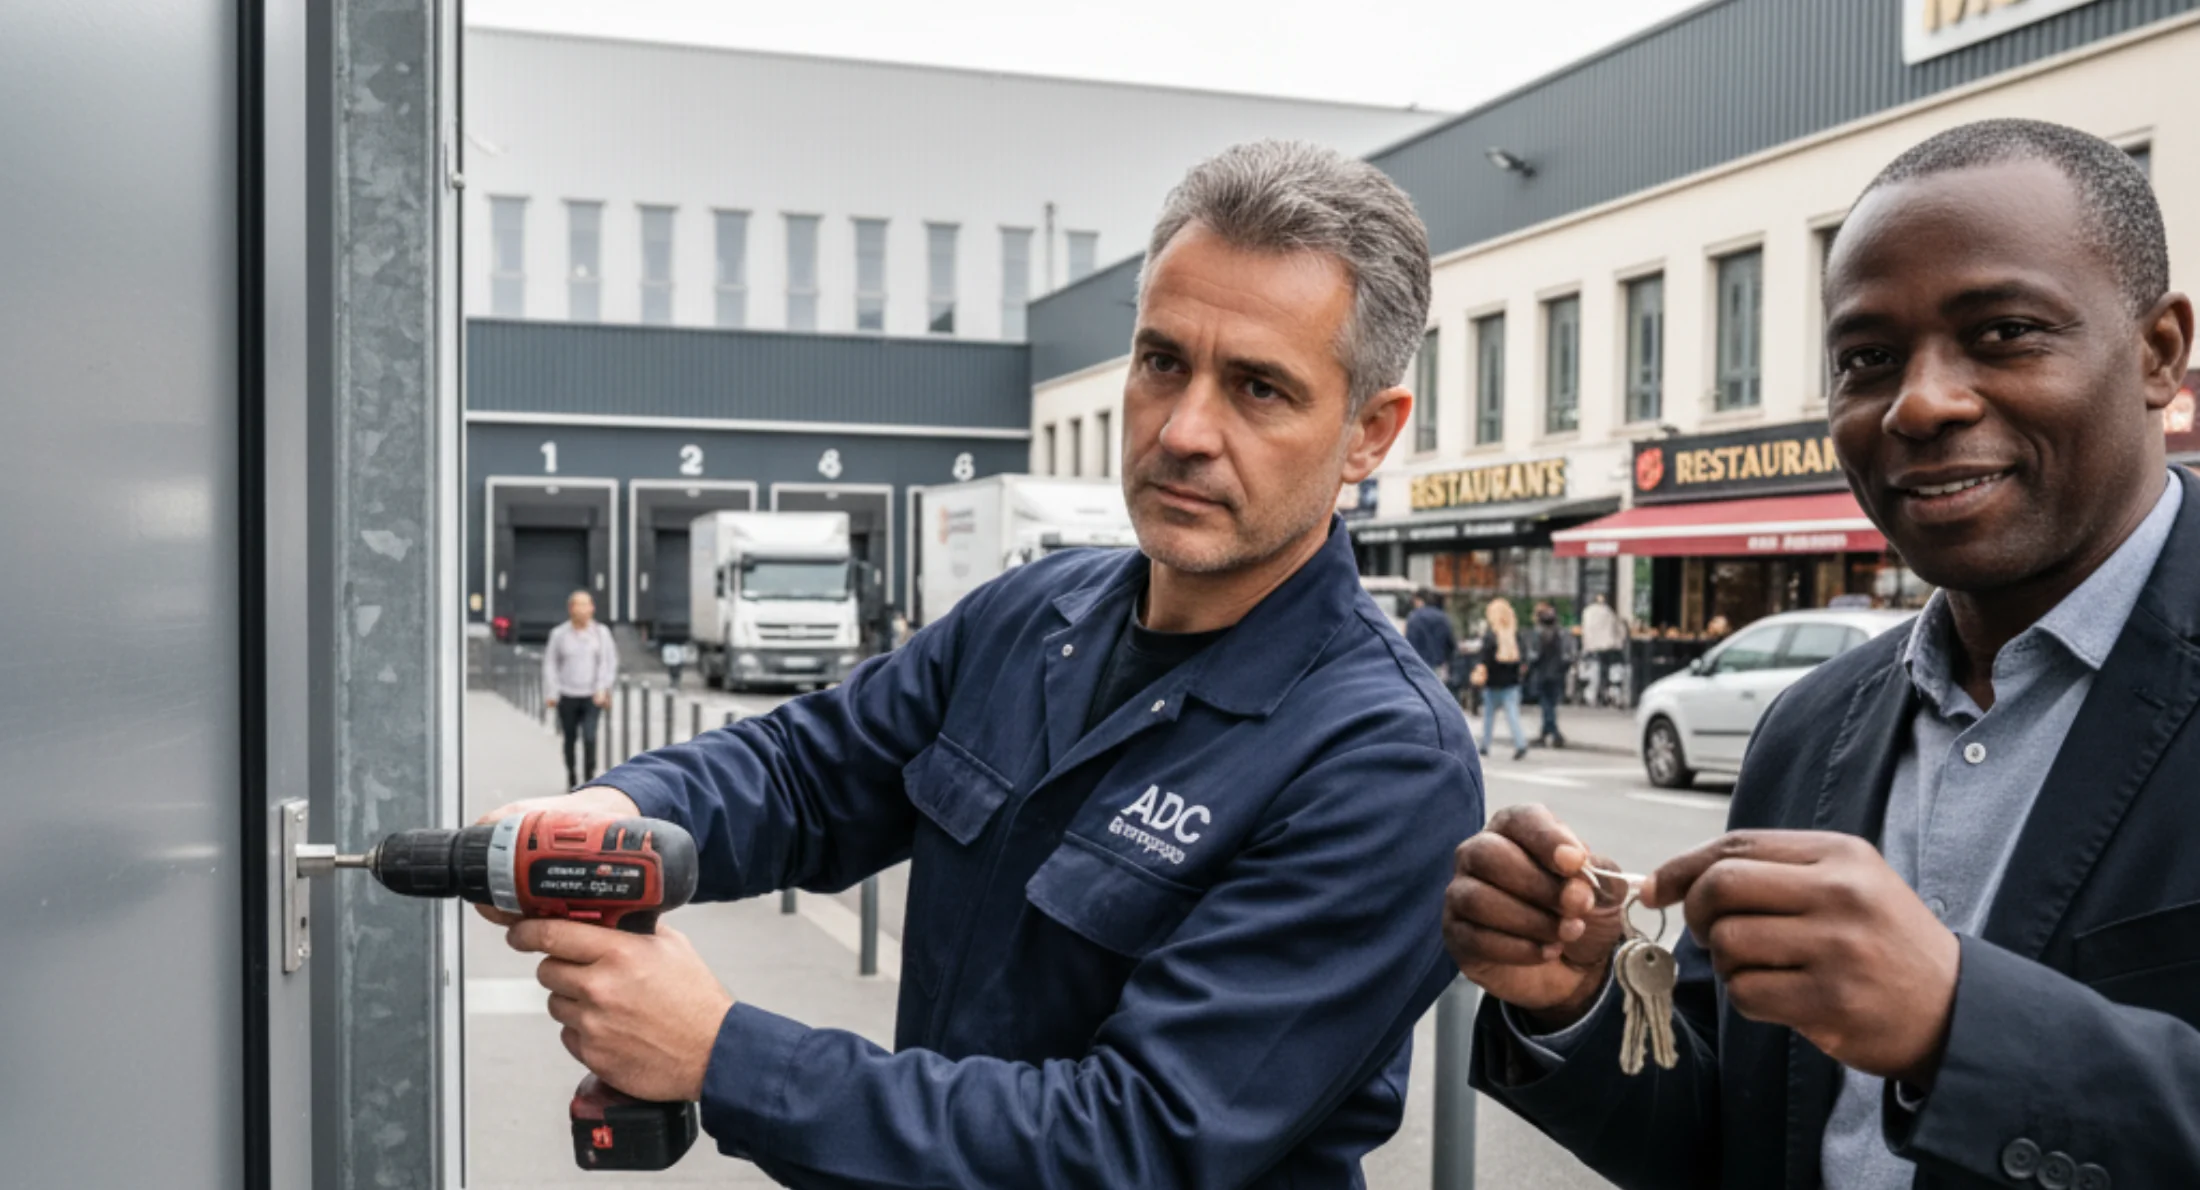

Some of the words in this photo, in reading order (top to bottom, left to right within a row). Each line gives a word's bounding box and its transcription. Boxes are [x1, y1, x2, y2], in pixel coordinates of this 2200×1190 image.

[540, 441, 557, 473] 1
[679, 444, 703, 475] 2
[1120, 784, 1211, 843] ADC
